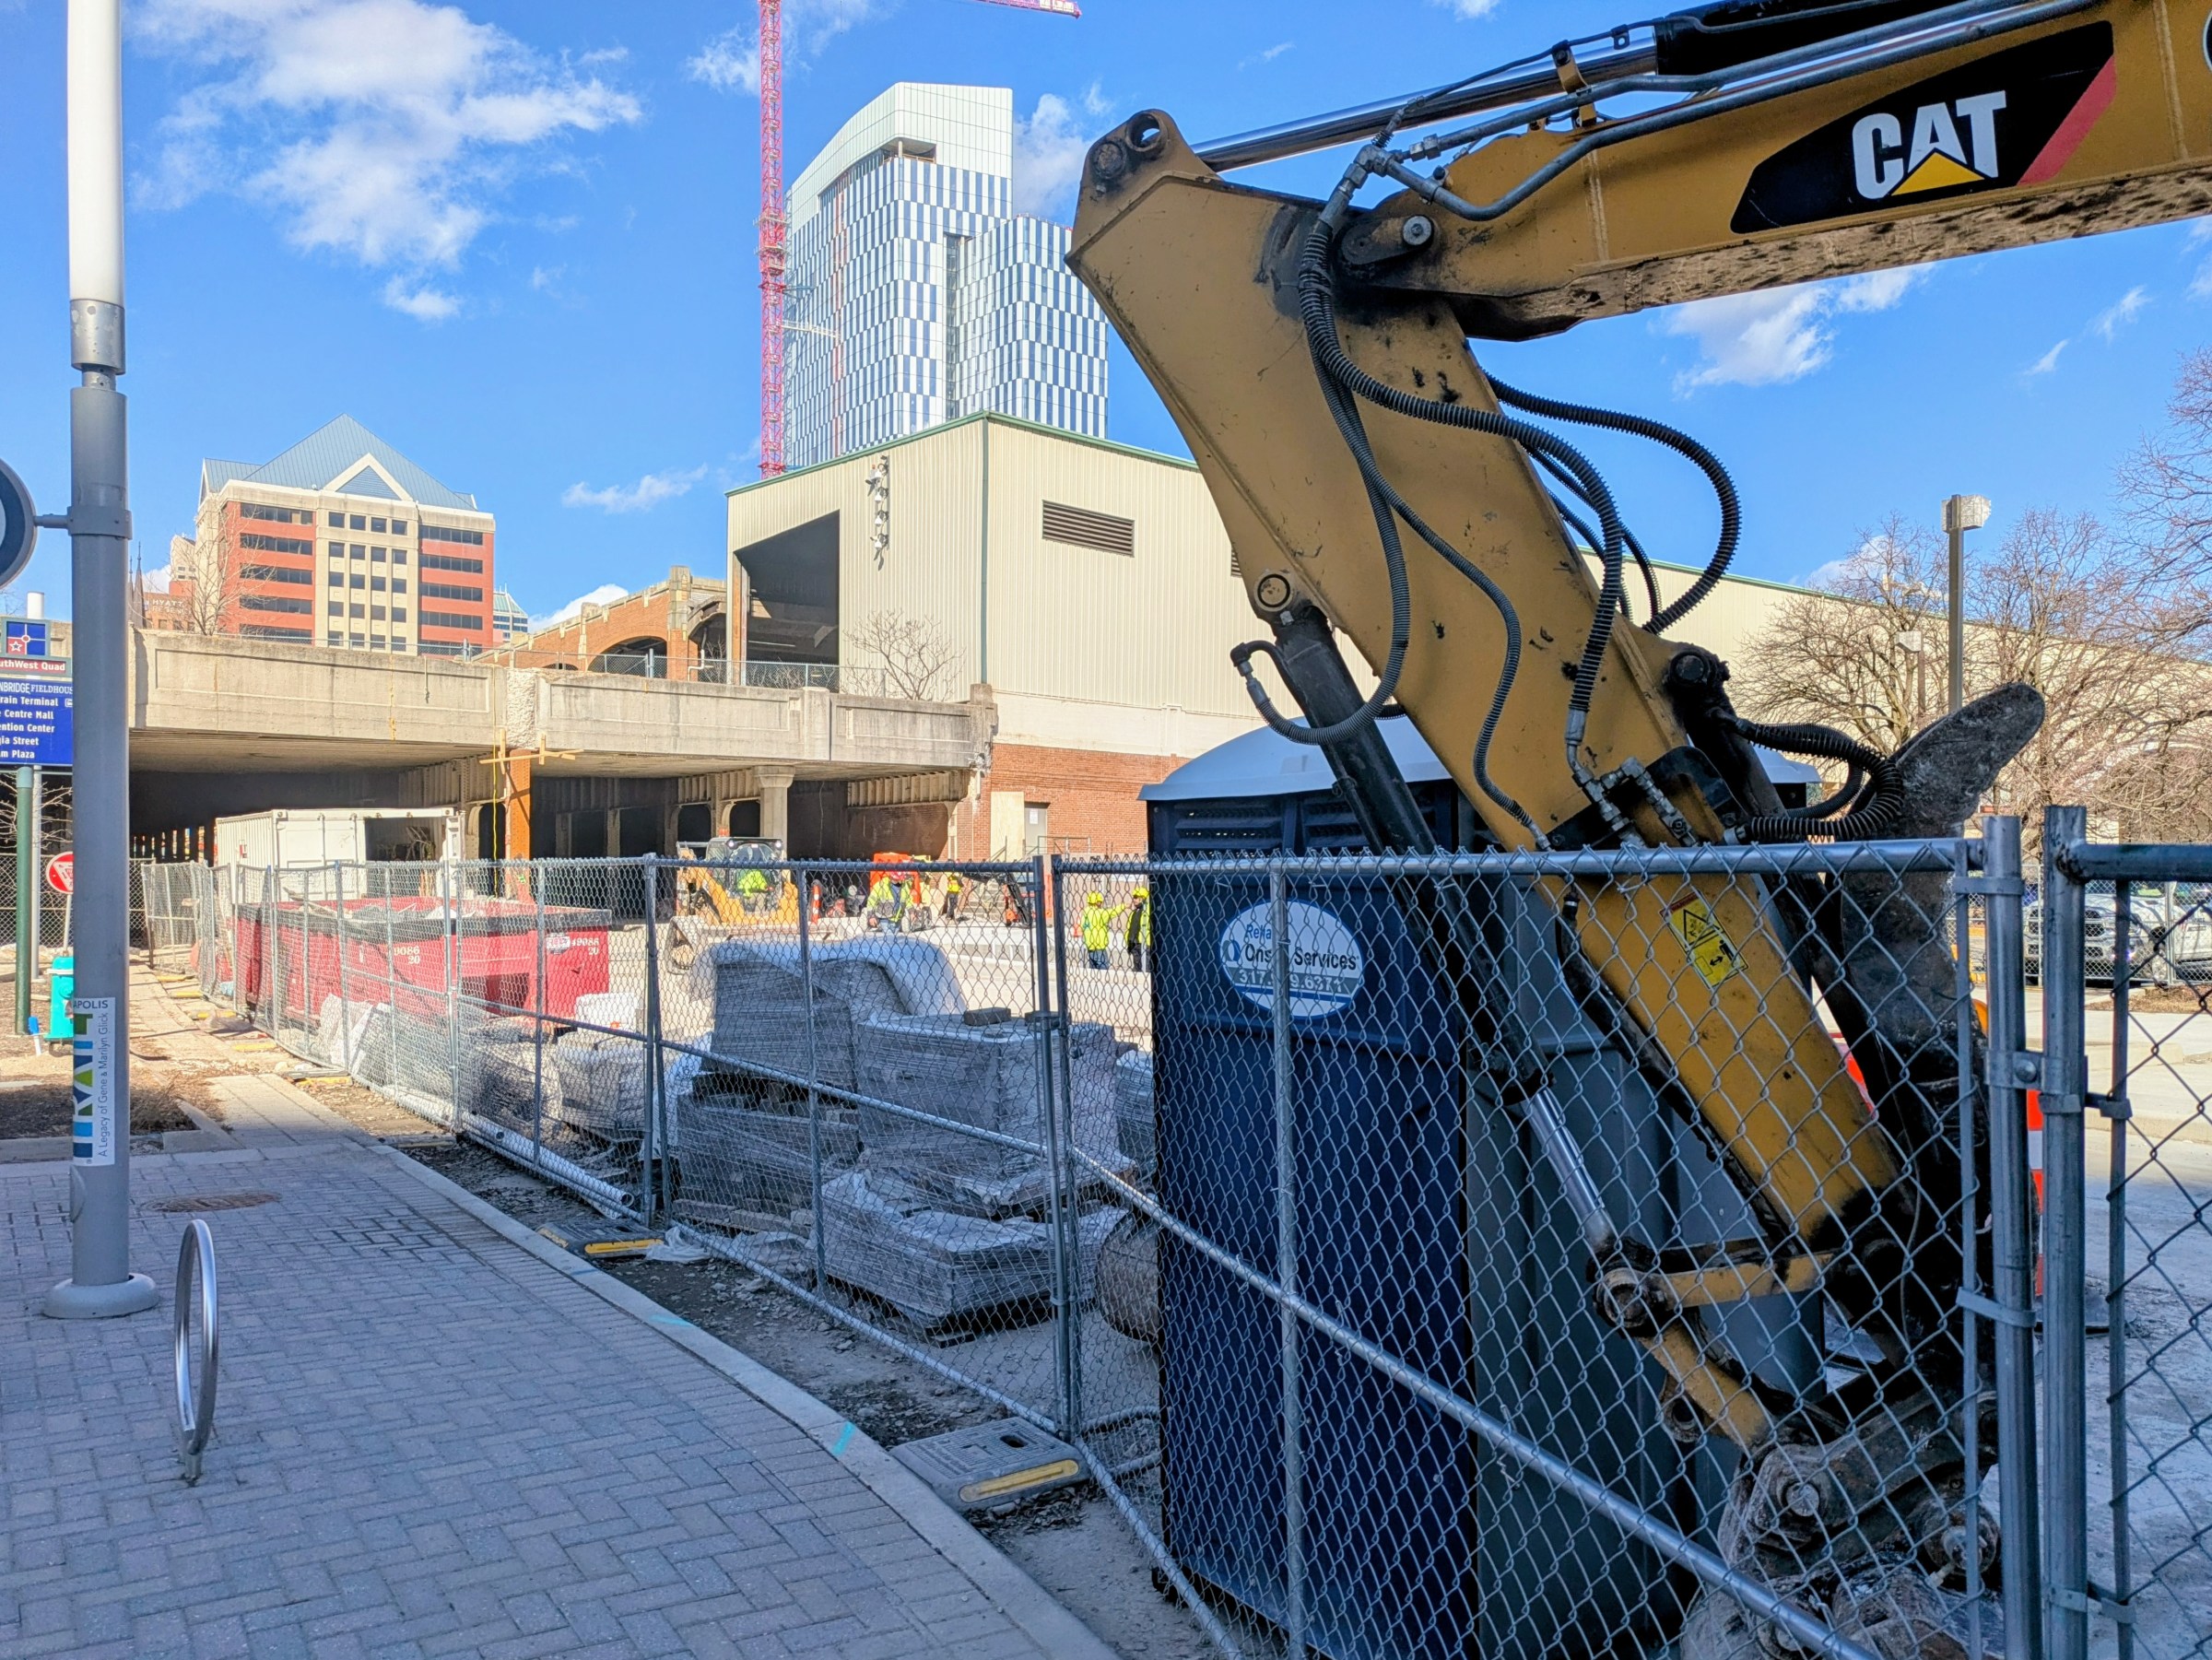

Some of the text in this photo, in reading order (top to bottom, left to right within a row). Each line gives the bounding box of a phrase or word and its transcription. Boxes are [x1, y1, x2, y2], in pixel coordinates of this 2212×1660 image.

[1853, 90, 2006, 199] CAT
[152, 599, 183, 607] HYATT
[41, 662, 65, 671] Quad
[30, 684, 73, 694] FIELDHOUS
[20, 696, 58, 707] Terminal
[5, 709, 32, 719] Centre
[36, 711, 54, 719] Mall
[27, 724, 55, 733] Center
[13, 736, 39, 746] Street
[12, 749, 35, 759] Plaza
[1294, 946, 1357, 971] Services
[98, 1013, 109, 1035] Glick
[98, 1037, 111, 1069] Marilyn
[98, 1078, 108, 1103] Gene
[97, 1104, 108, 1114] of
[98, 1116, 111, 1148] Legacy
[99, 1148, 108, 1158] A
